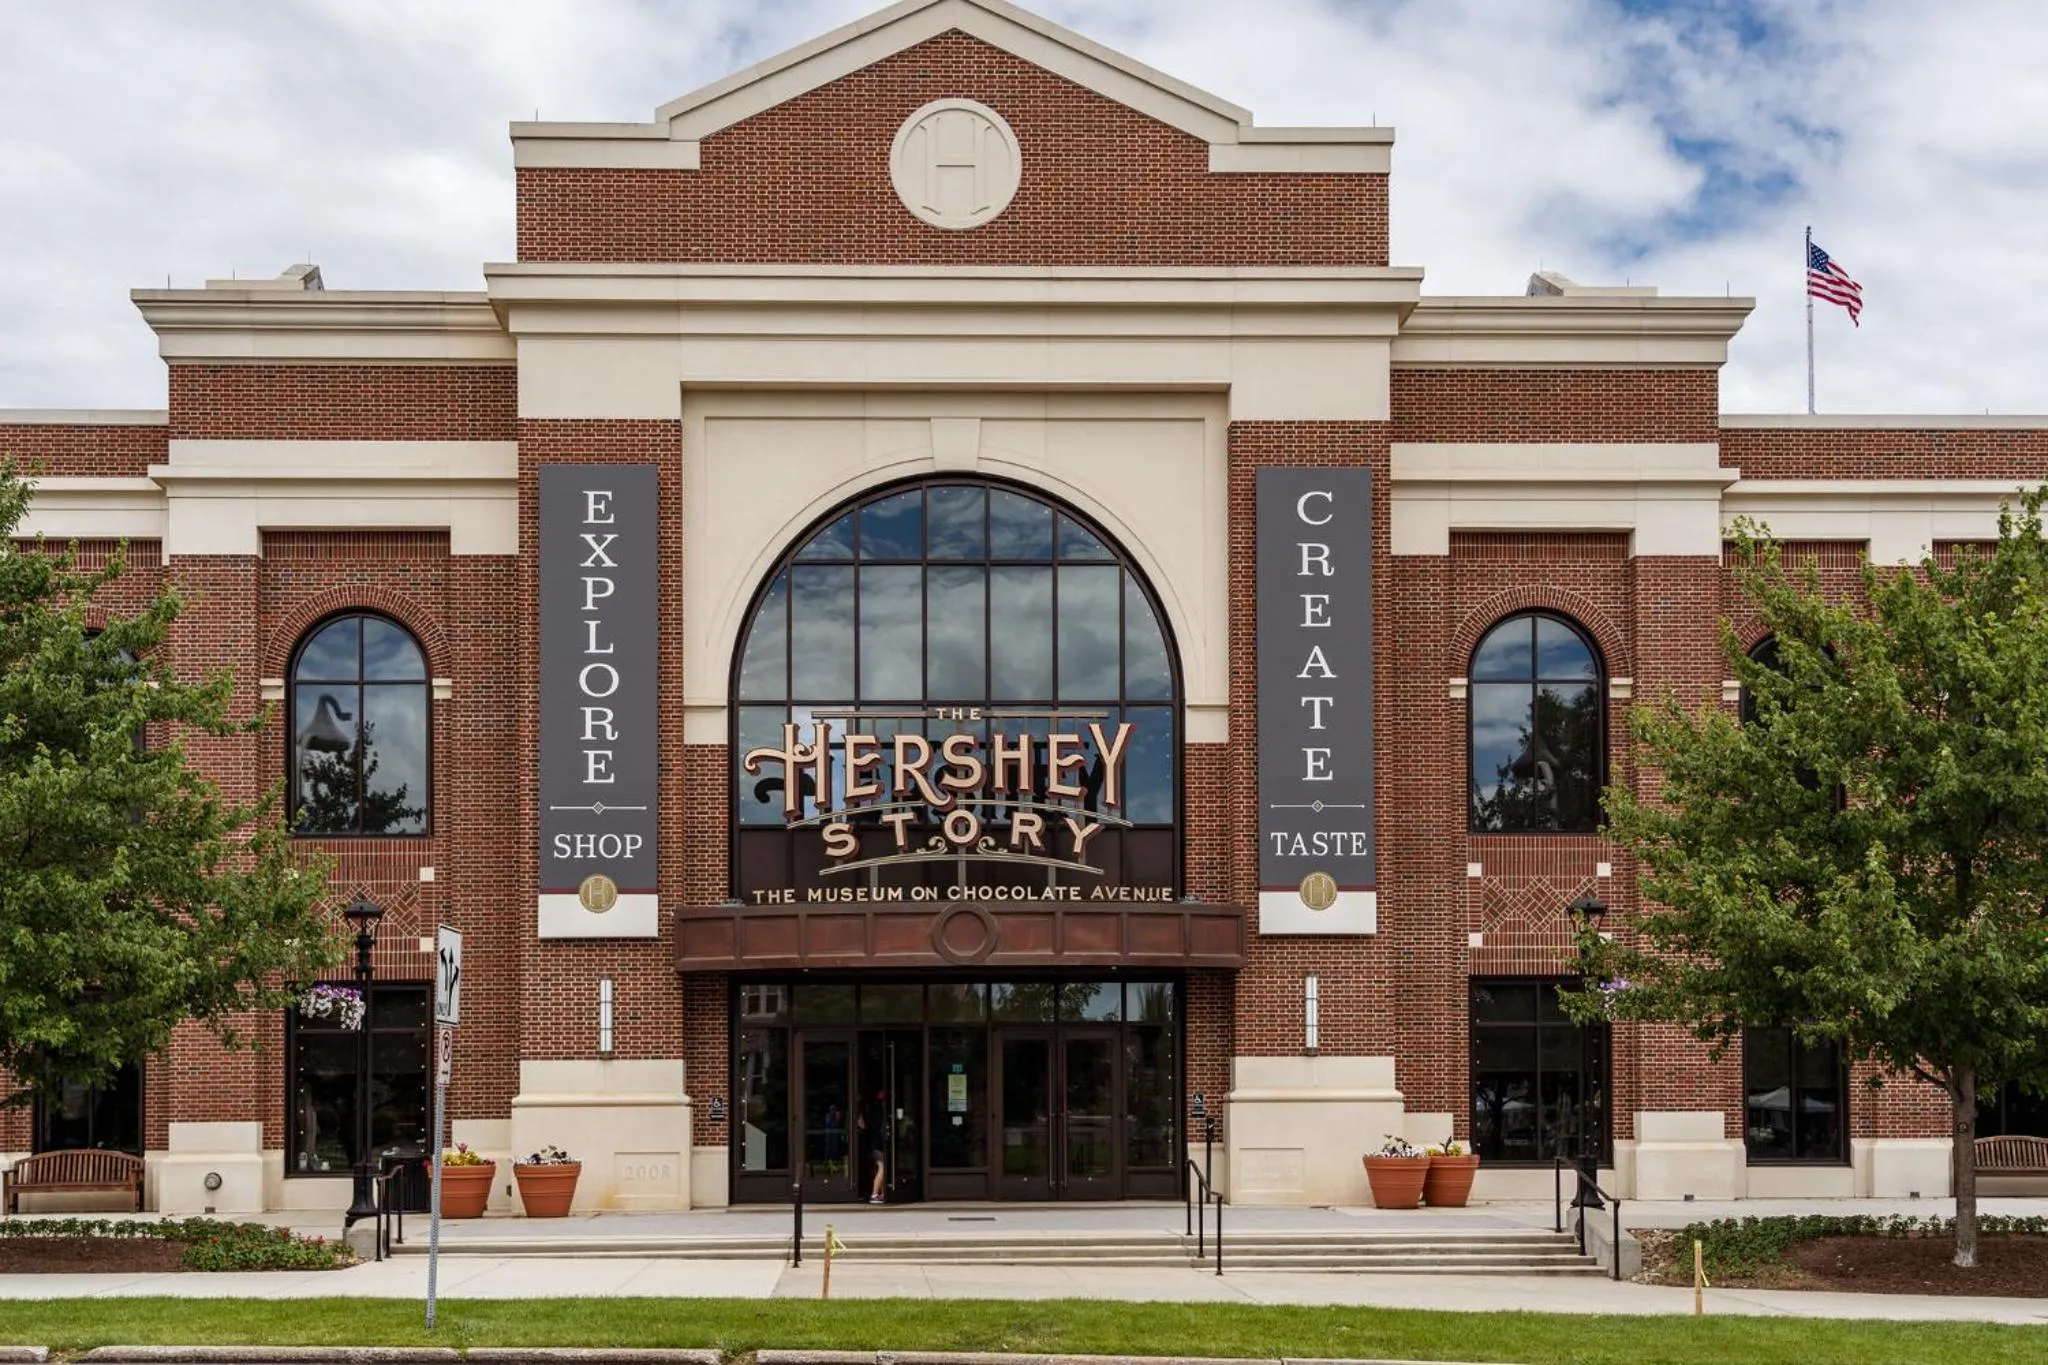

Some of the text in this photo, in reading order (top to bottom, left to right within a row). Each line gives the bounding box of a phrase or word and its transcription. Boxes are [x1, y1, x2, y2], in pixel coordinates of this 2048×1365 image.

[578, 489, 620, 784] EXPLORE
[1296, 490, 1338, 782] CREATE
[935, 707, 982, 721] THE
[743, 722, 1136, 819] HERSHEY
[553, 833, 643, 859] SHOP
[820, 809, 1105, 862] STORY
[1270, 831, 1368, 857] TASTE
[752, 885, 1173, 904] THE MUSEUM ON CHOCOLATE AVENUE
[623, 1164, 671, 1182] 2008
